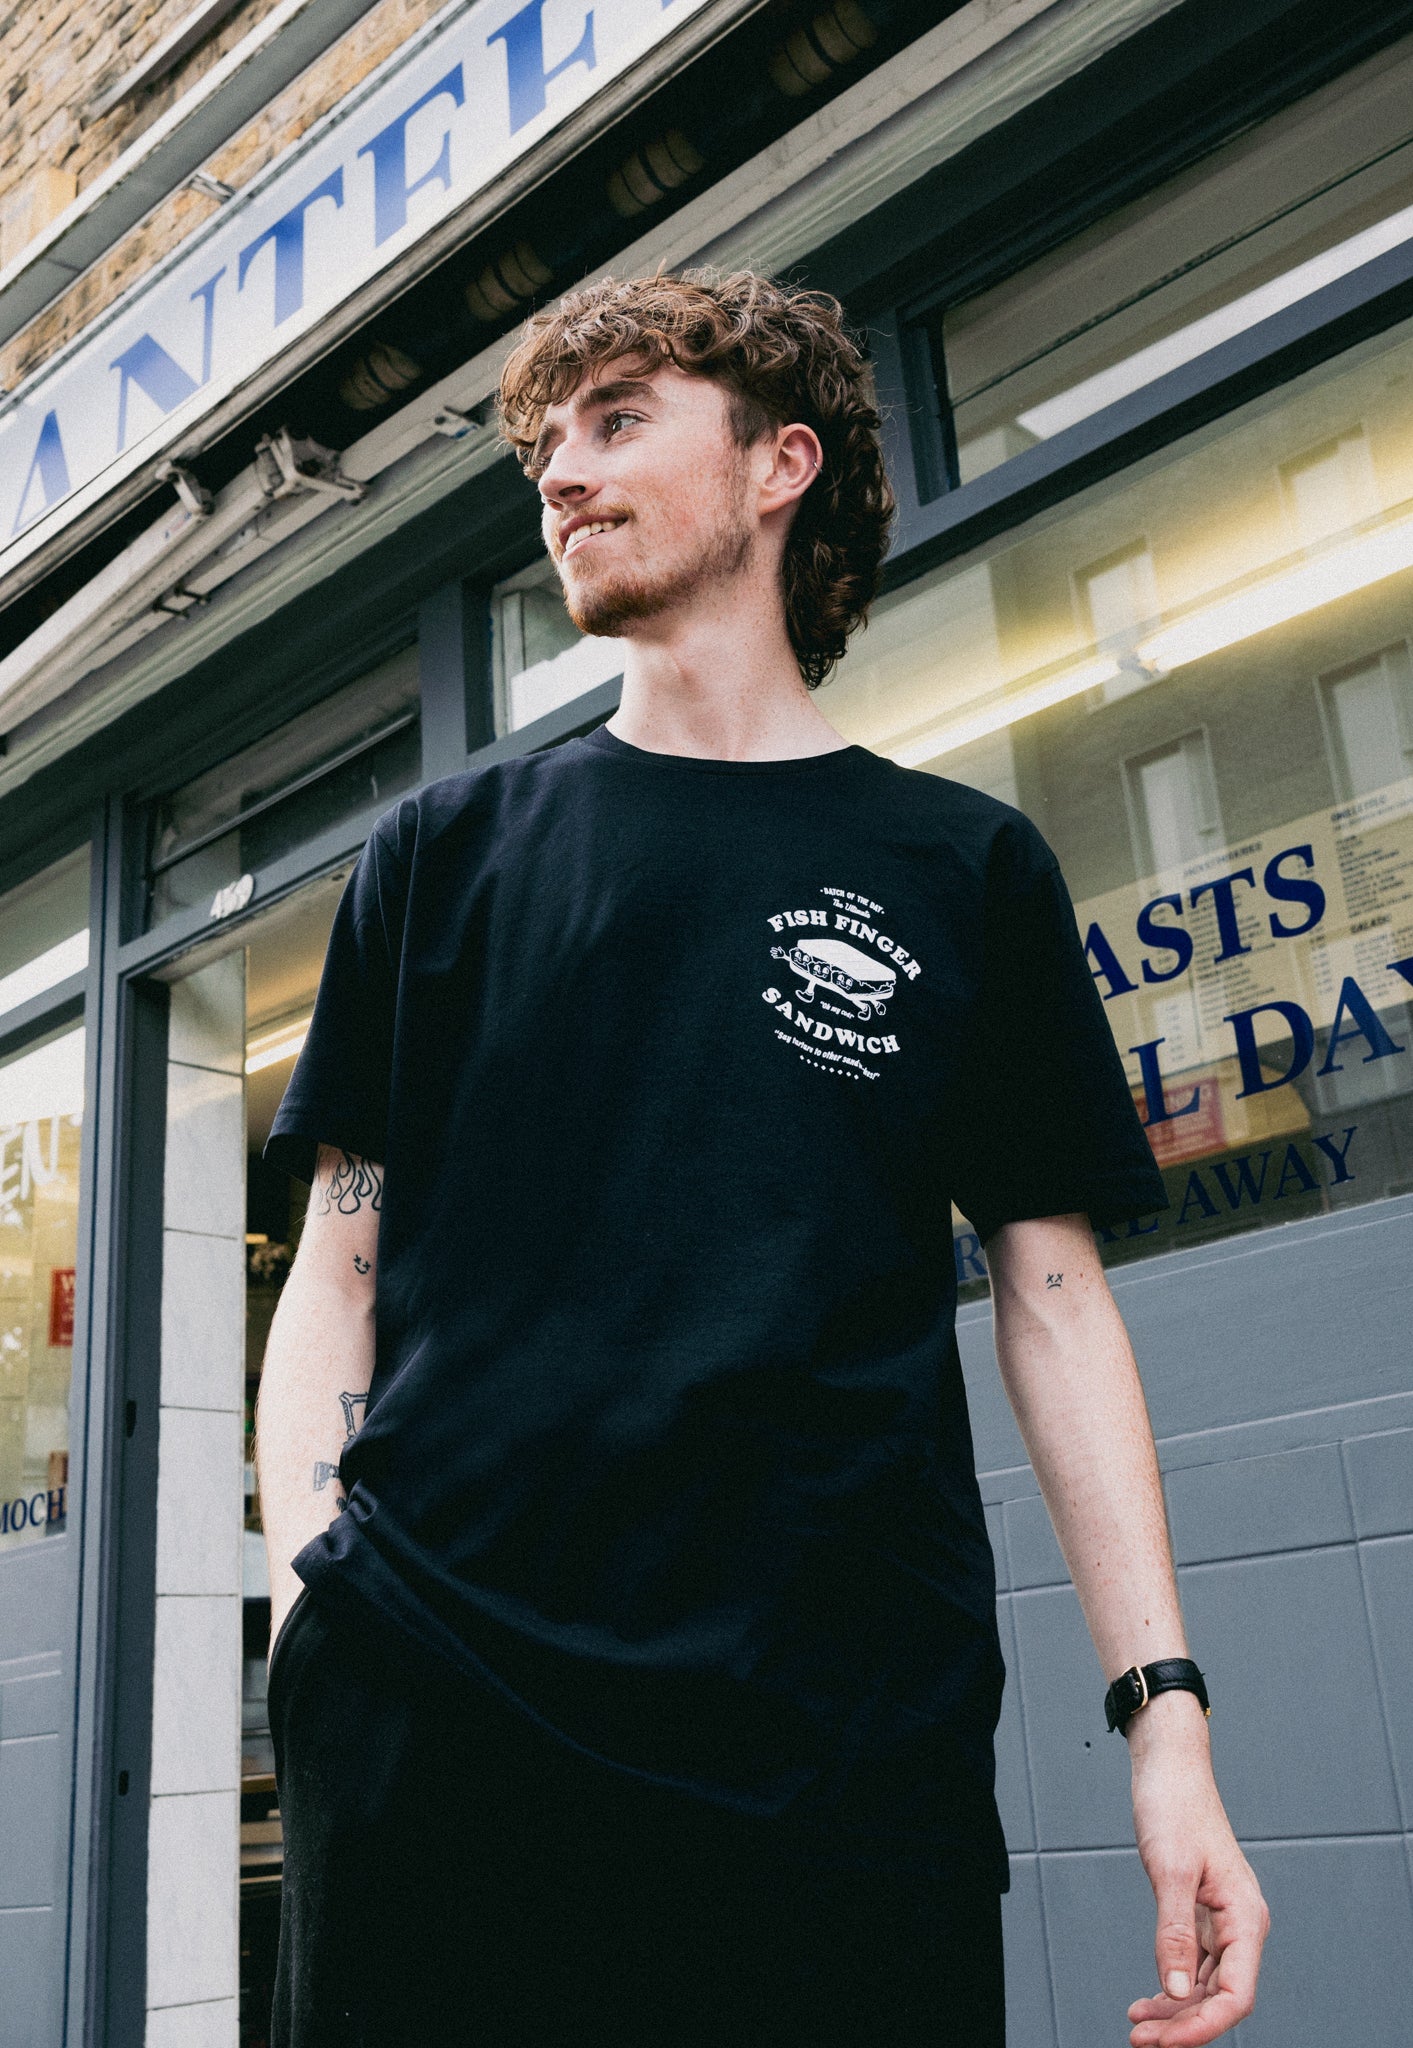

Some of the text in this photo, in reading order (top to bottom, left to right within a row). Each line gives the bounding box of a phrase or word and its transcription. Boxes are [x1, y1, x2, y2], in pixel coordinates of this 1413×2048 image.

[846, 891, 855, 900] OF
[767, 910, 922, 980] FISH FINGER
[762, 987, 900, 1054] SANDWICH
[1223, 955, 1413, 1100] DA
[1176, 1126, 1359, 1226] AWAY
